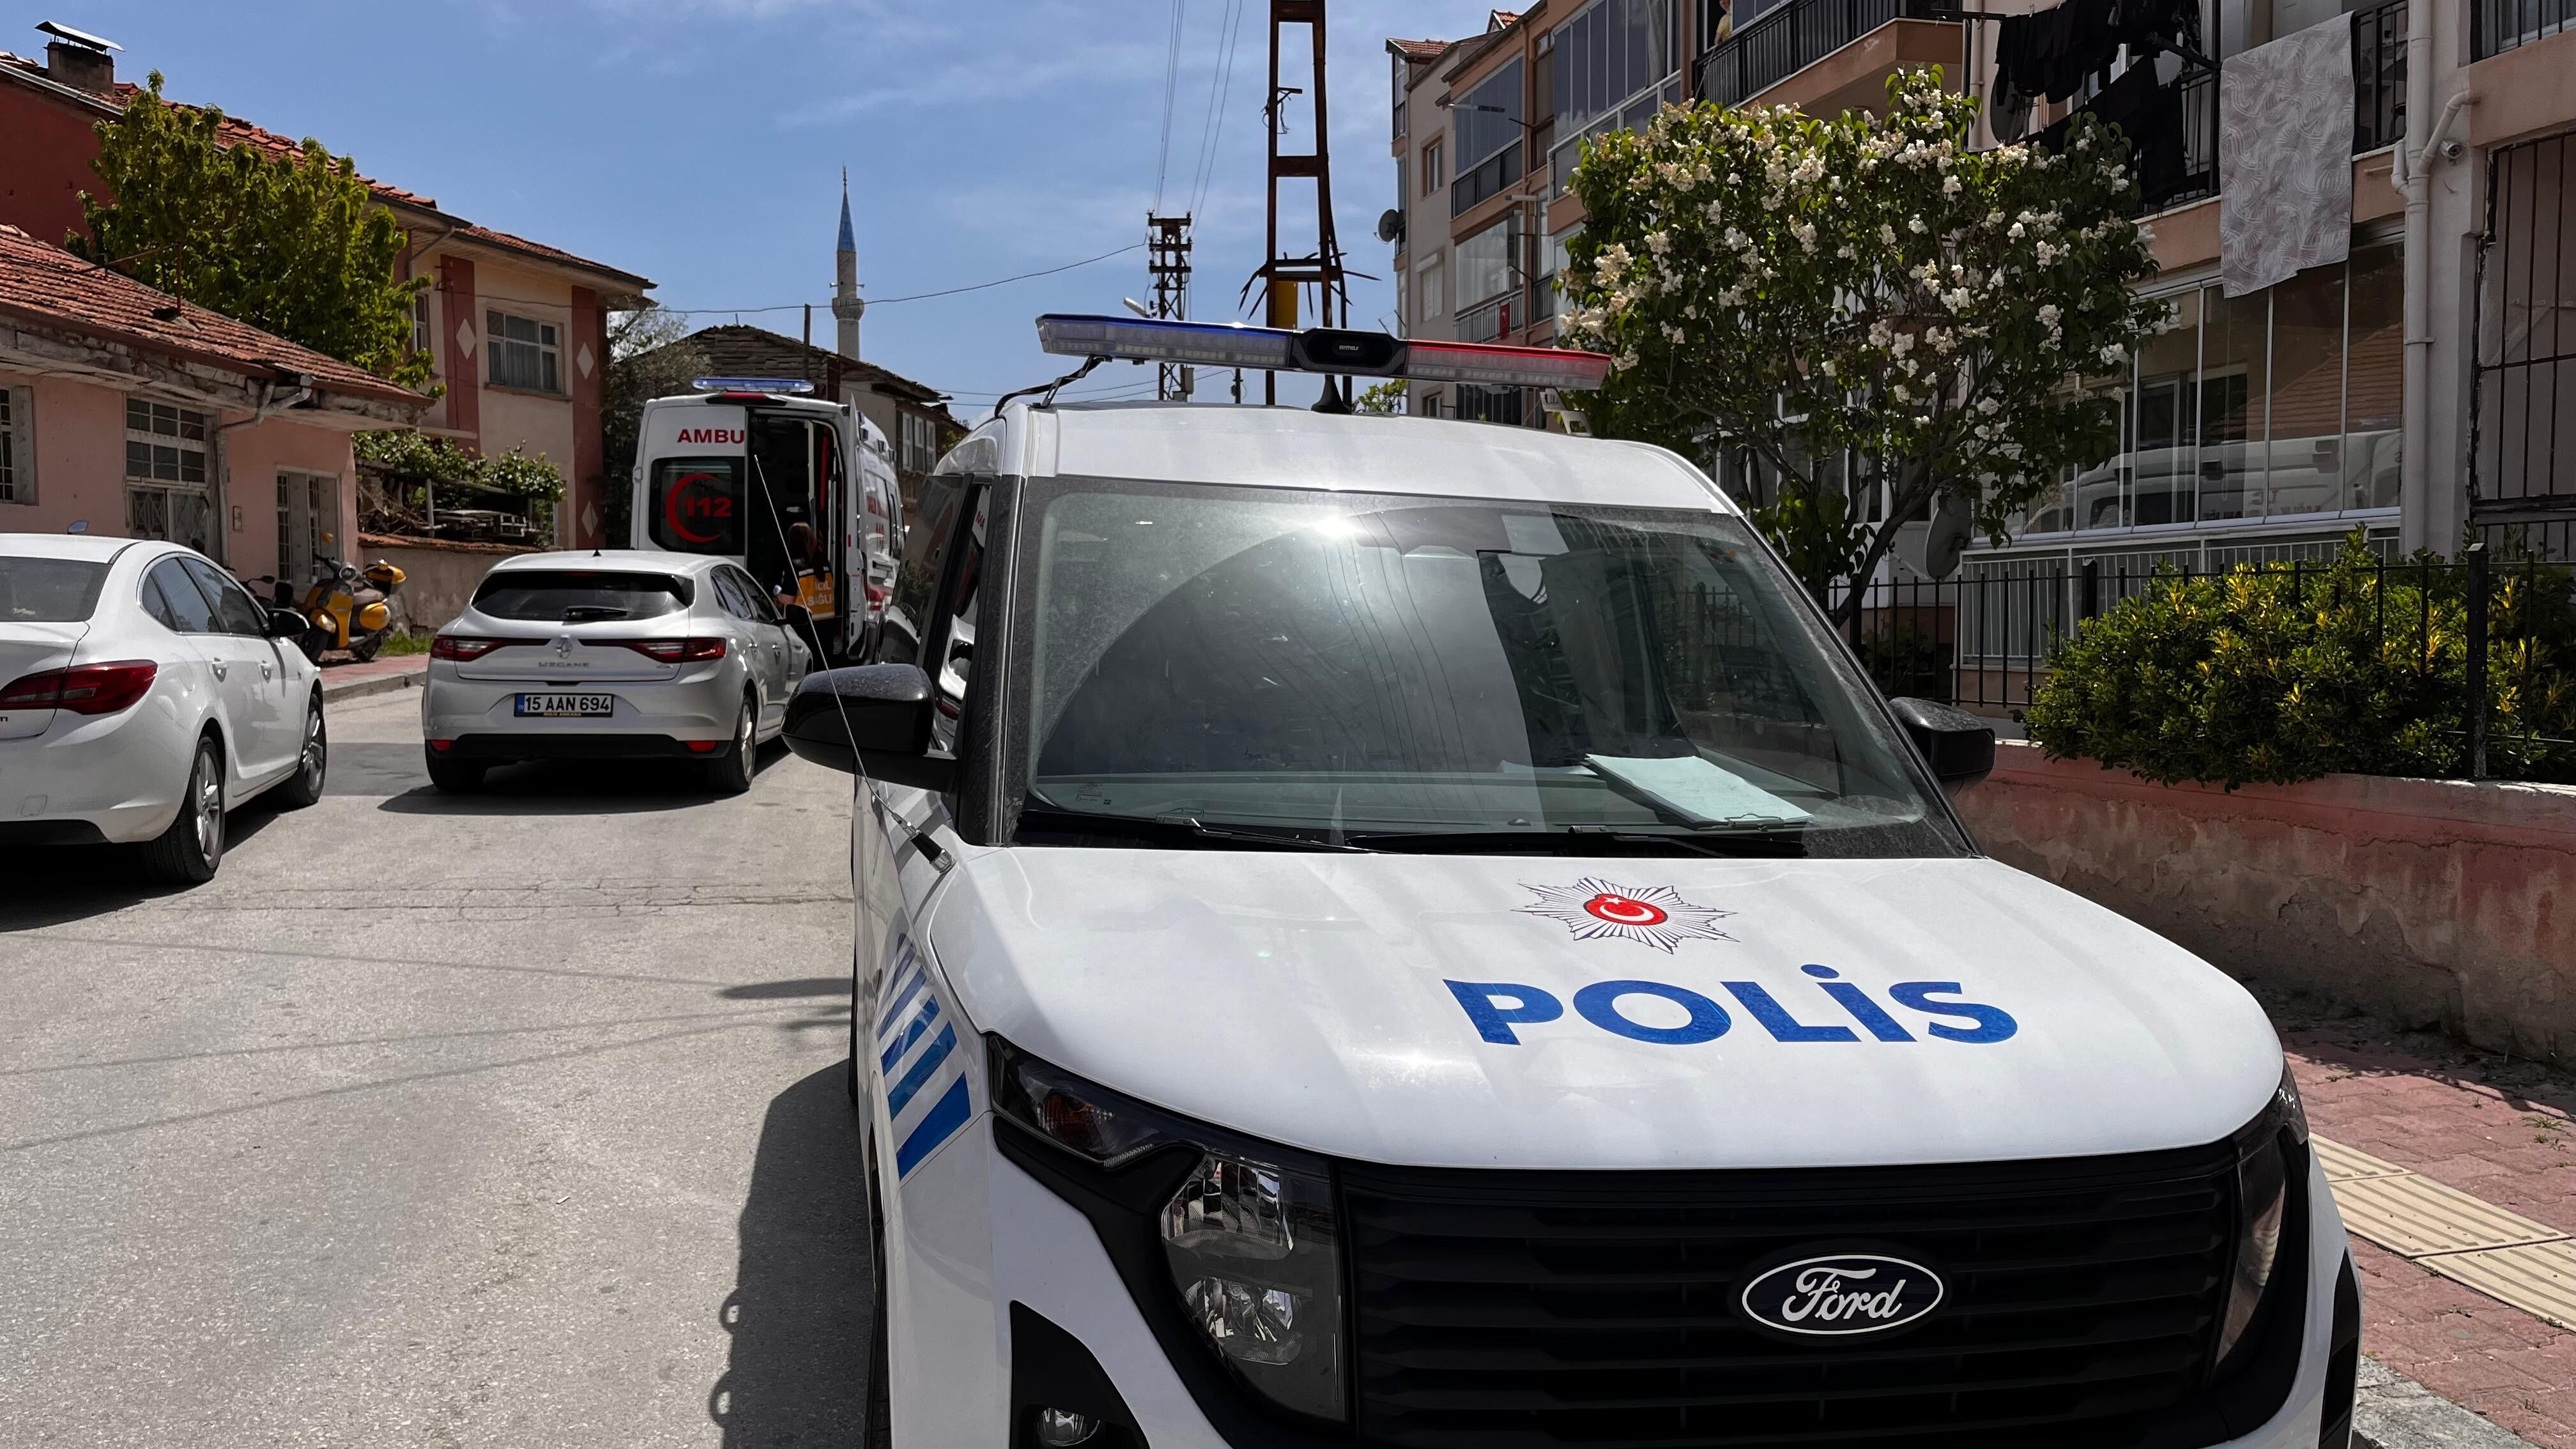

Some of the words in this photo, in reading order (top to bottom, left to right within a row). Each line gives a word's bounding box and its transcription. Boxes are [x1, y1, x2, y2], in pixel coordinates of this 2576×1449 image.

[677, 429, 745, 444] AMBU
[683, 496, 732, 518] 112
[526, 696, 541, 711] 15
[546, 696, 576, 711] AAN
[579, 696, 610, 711] 694
[1441, 963, 2018, 1046] POLİS
[1782, 1267, 1906, 1322] Ford
